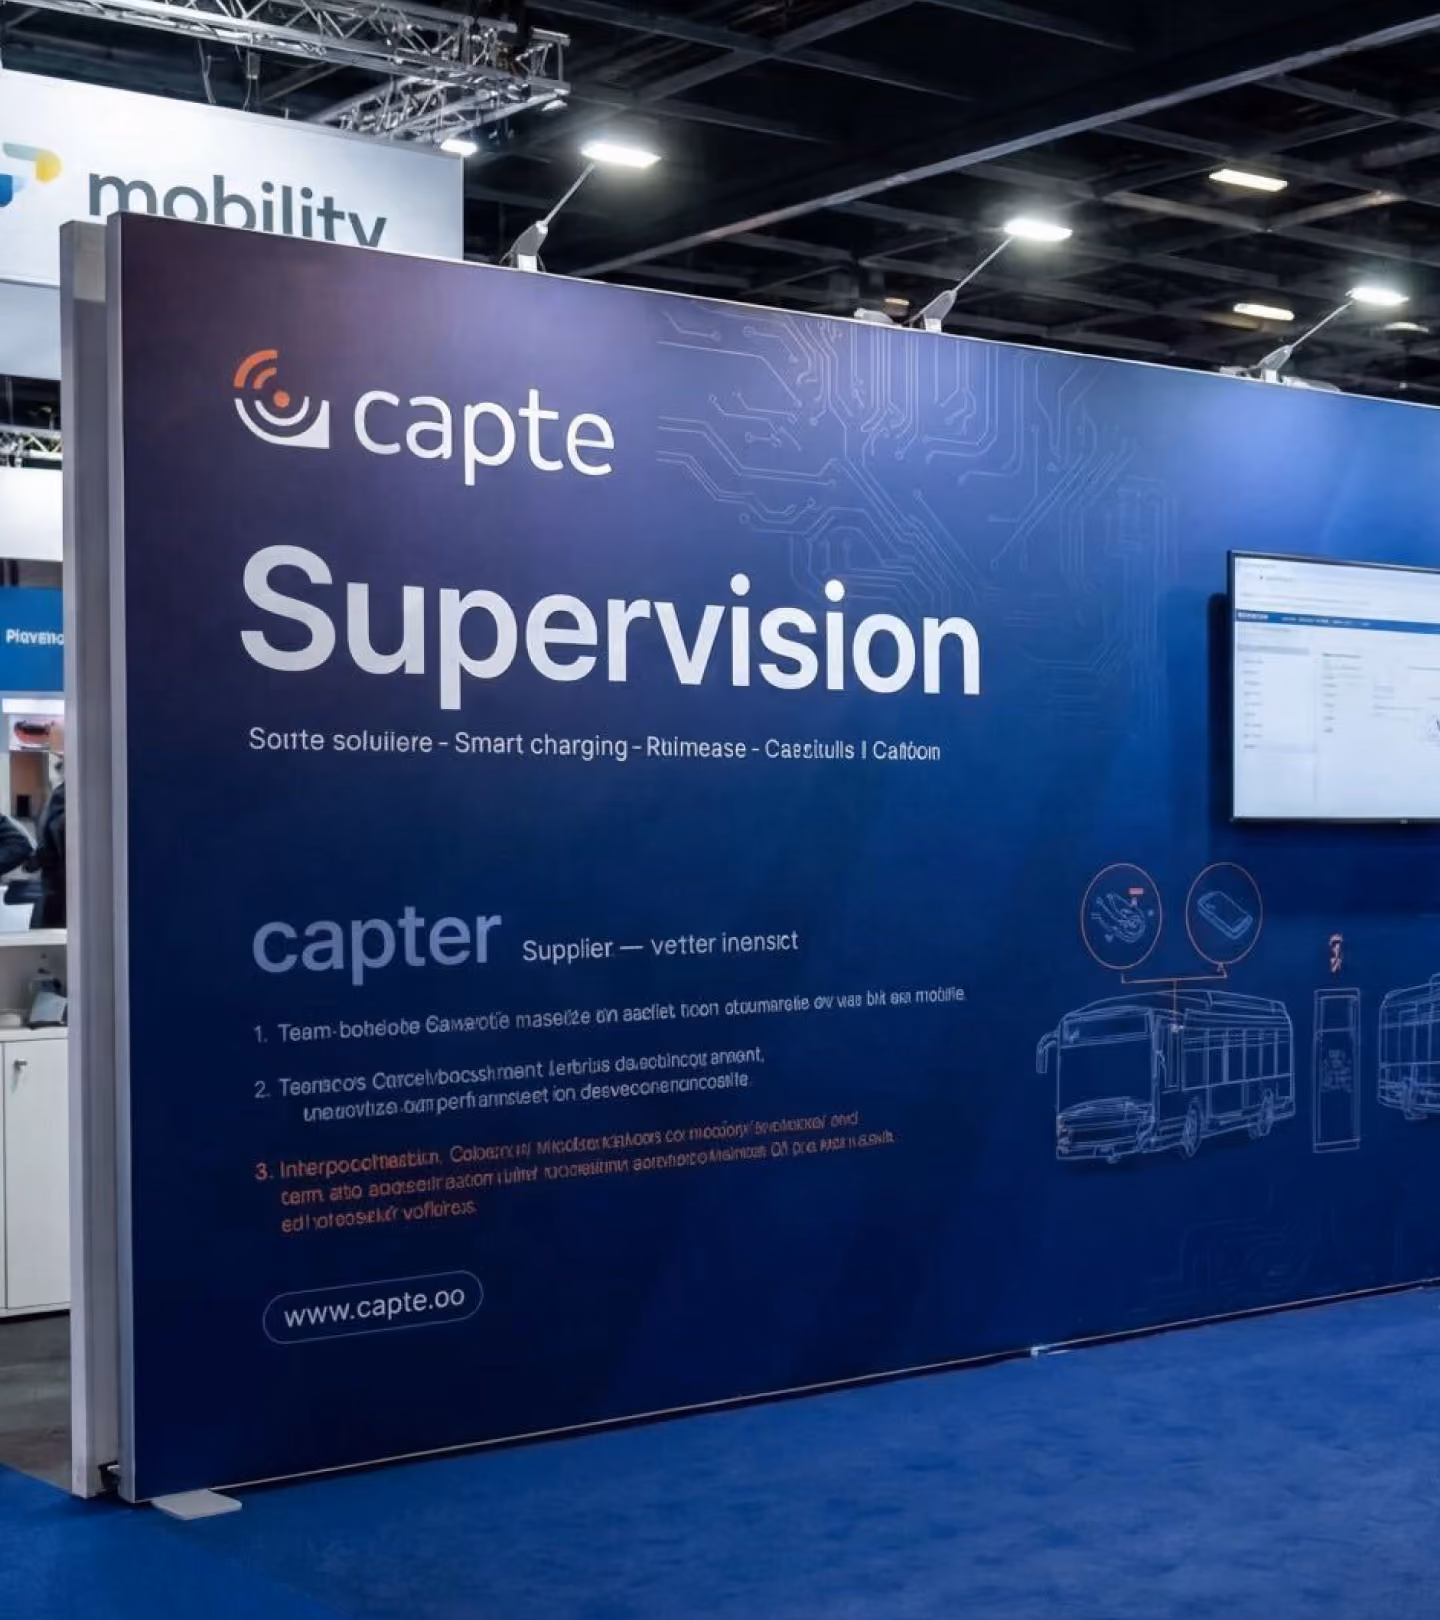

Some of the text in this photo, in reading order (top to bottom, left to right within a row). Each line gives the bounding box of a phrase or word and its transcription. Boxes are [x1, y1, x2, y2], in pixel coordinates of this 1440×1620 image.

[353, 388, 615, 486] capte
[240, 544, 982, 711] Supervision
[454, 731, 523, 755] Smart
[529, 733, 628, 762] charging
[252, 905, 503, 987] capter
[521, 938, 614, 966] Supplier
[651, 934, 718, 957] vetter
[284, 1288, 466, 1329] www.capte.oo
